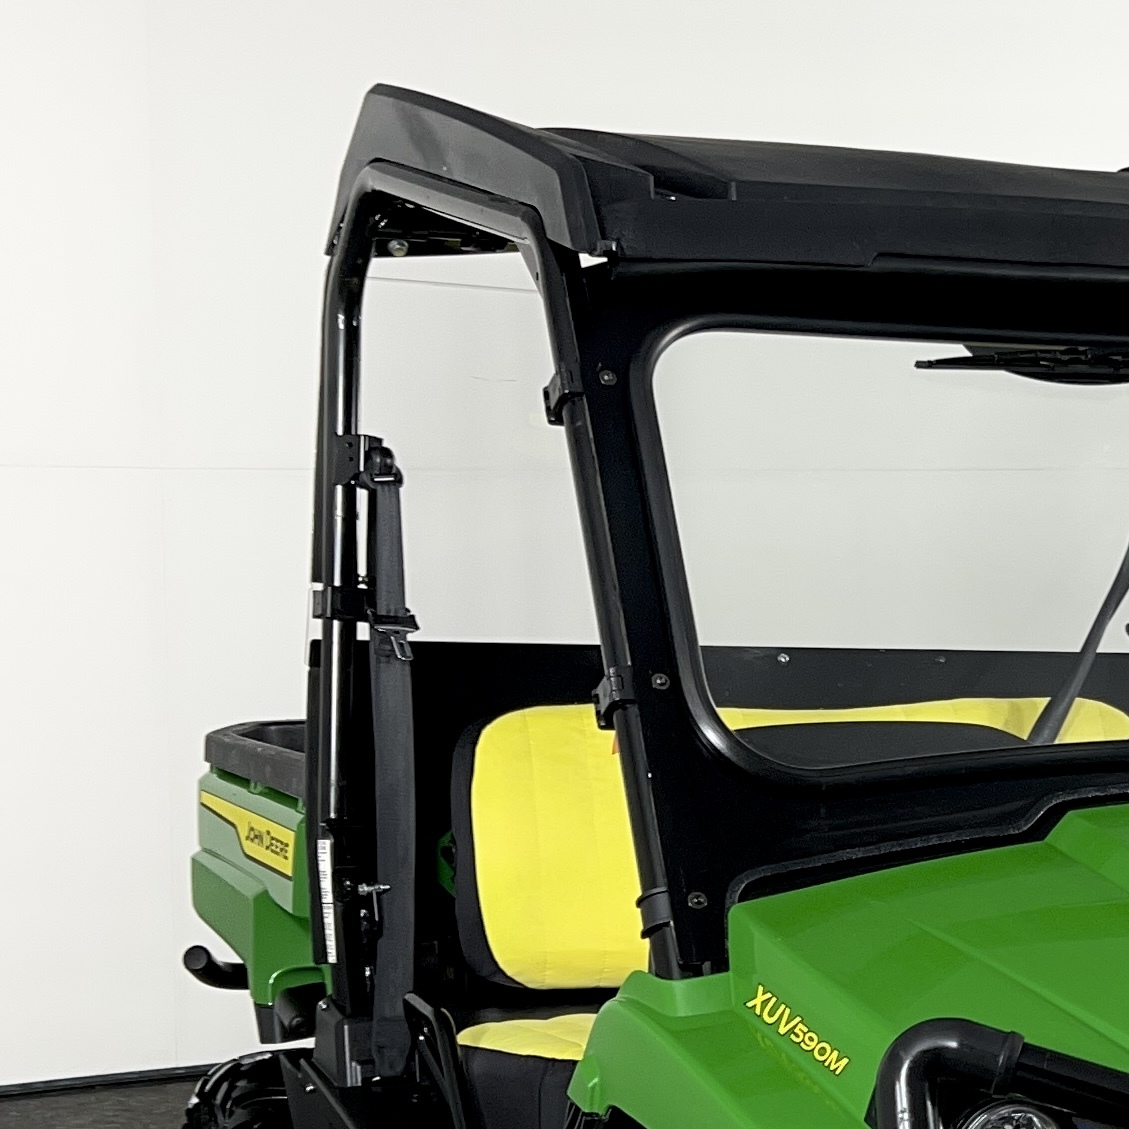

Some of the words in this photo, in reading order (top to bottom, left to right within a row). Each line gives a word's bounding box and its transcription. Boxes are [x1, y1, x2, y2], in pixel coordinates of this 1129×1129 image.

[245, 821, 265, 848] JOHN
[265, 829, 289, 861] DEERE
[744, 983, 850, 1076] XUV590M
